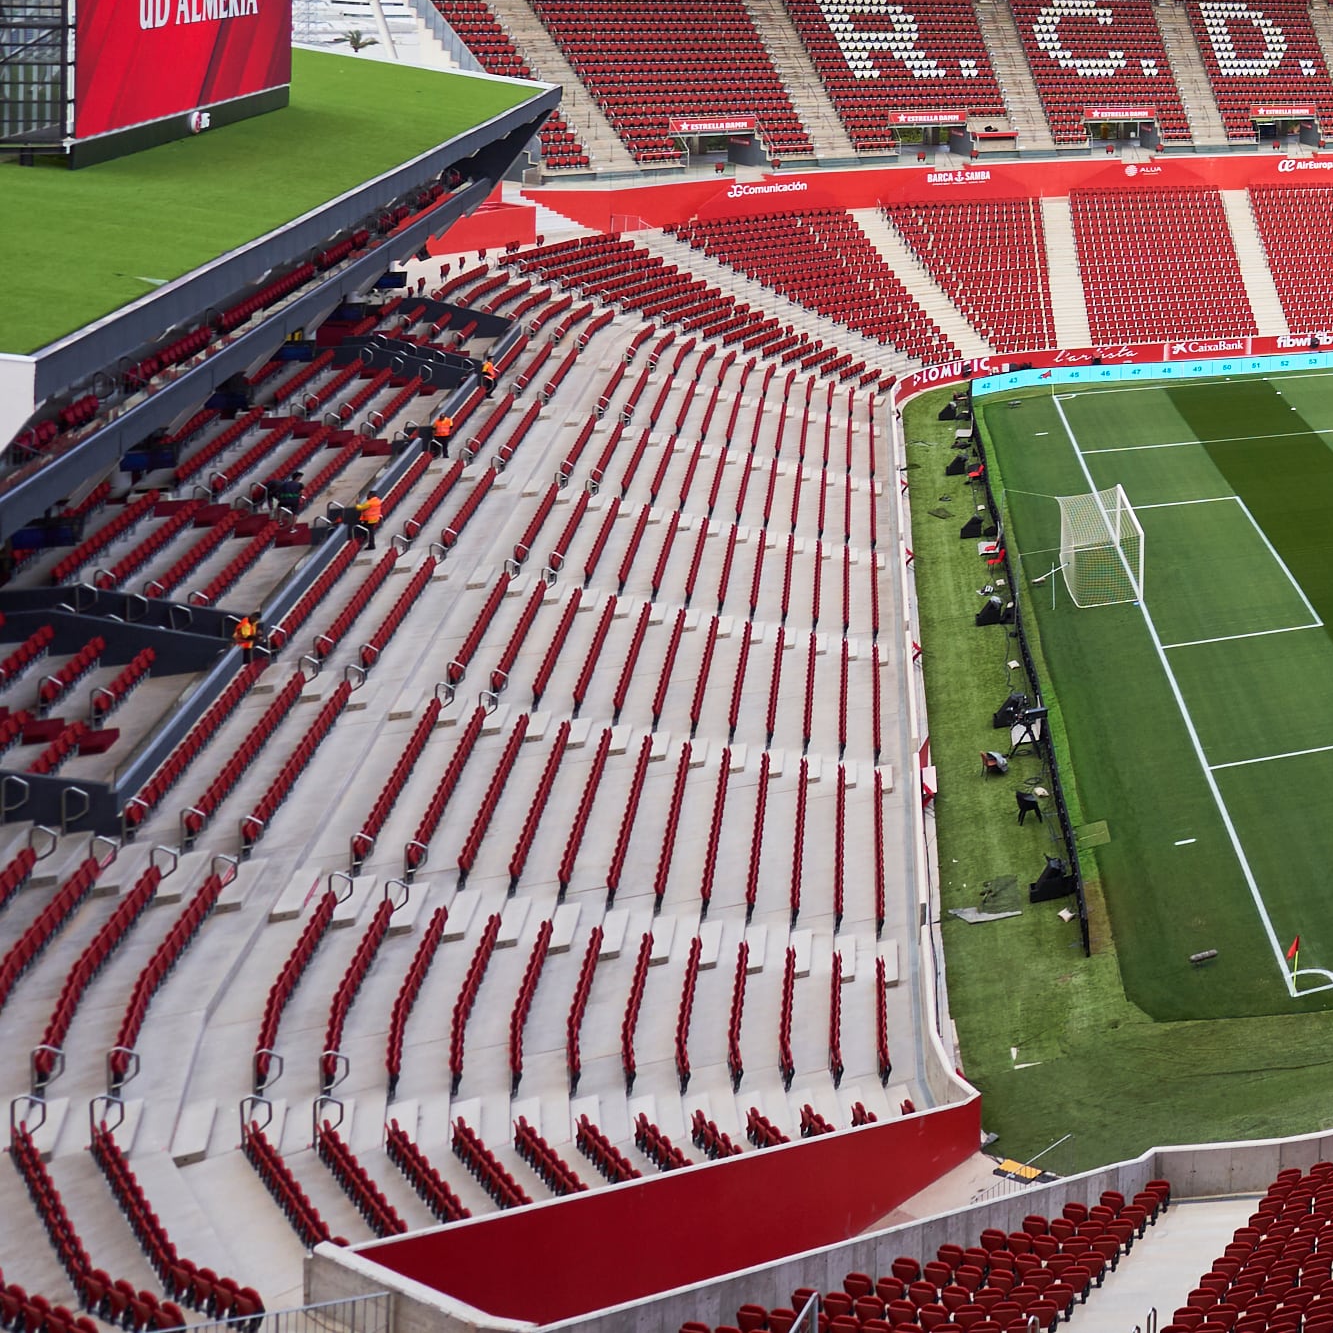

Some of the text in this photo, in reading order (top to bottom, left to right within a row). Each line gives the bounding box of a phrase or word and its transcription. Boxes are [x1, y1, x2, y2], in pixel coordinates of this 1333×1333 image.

[691, 121, 747, 130] ESTRELLA DAMM
[927, 171, 991, 183] BARCA SAMBA
[1188, 340, 1244, 353] CaixaBank
[1276, 334, 1311, 348] fibwi
